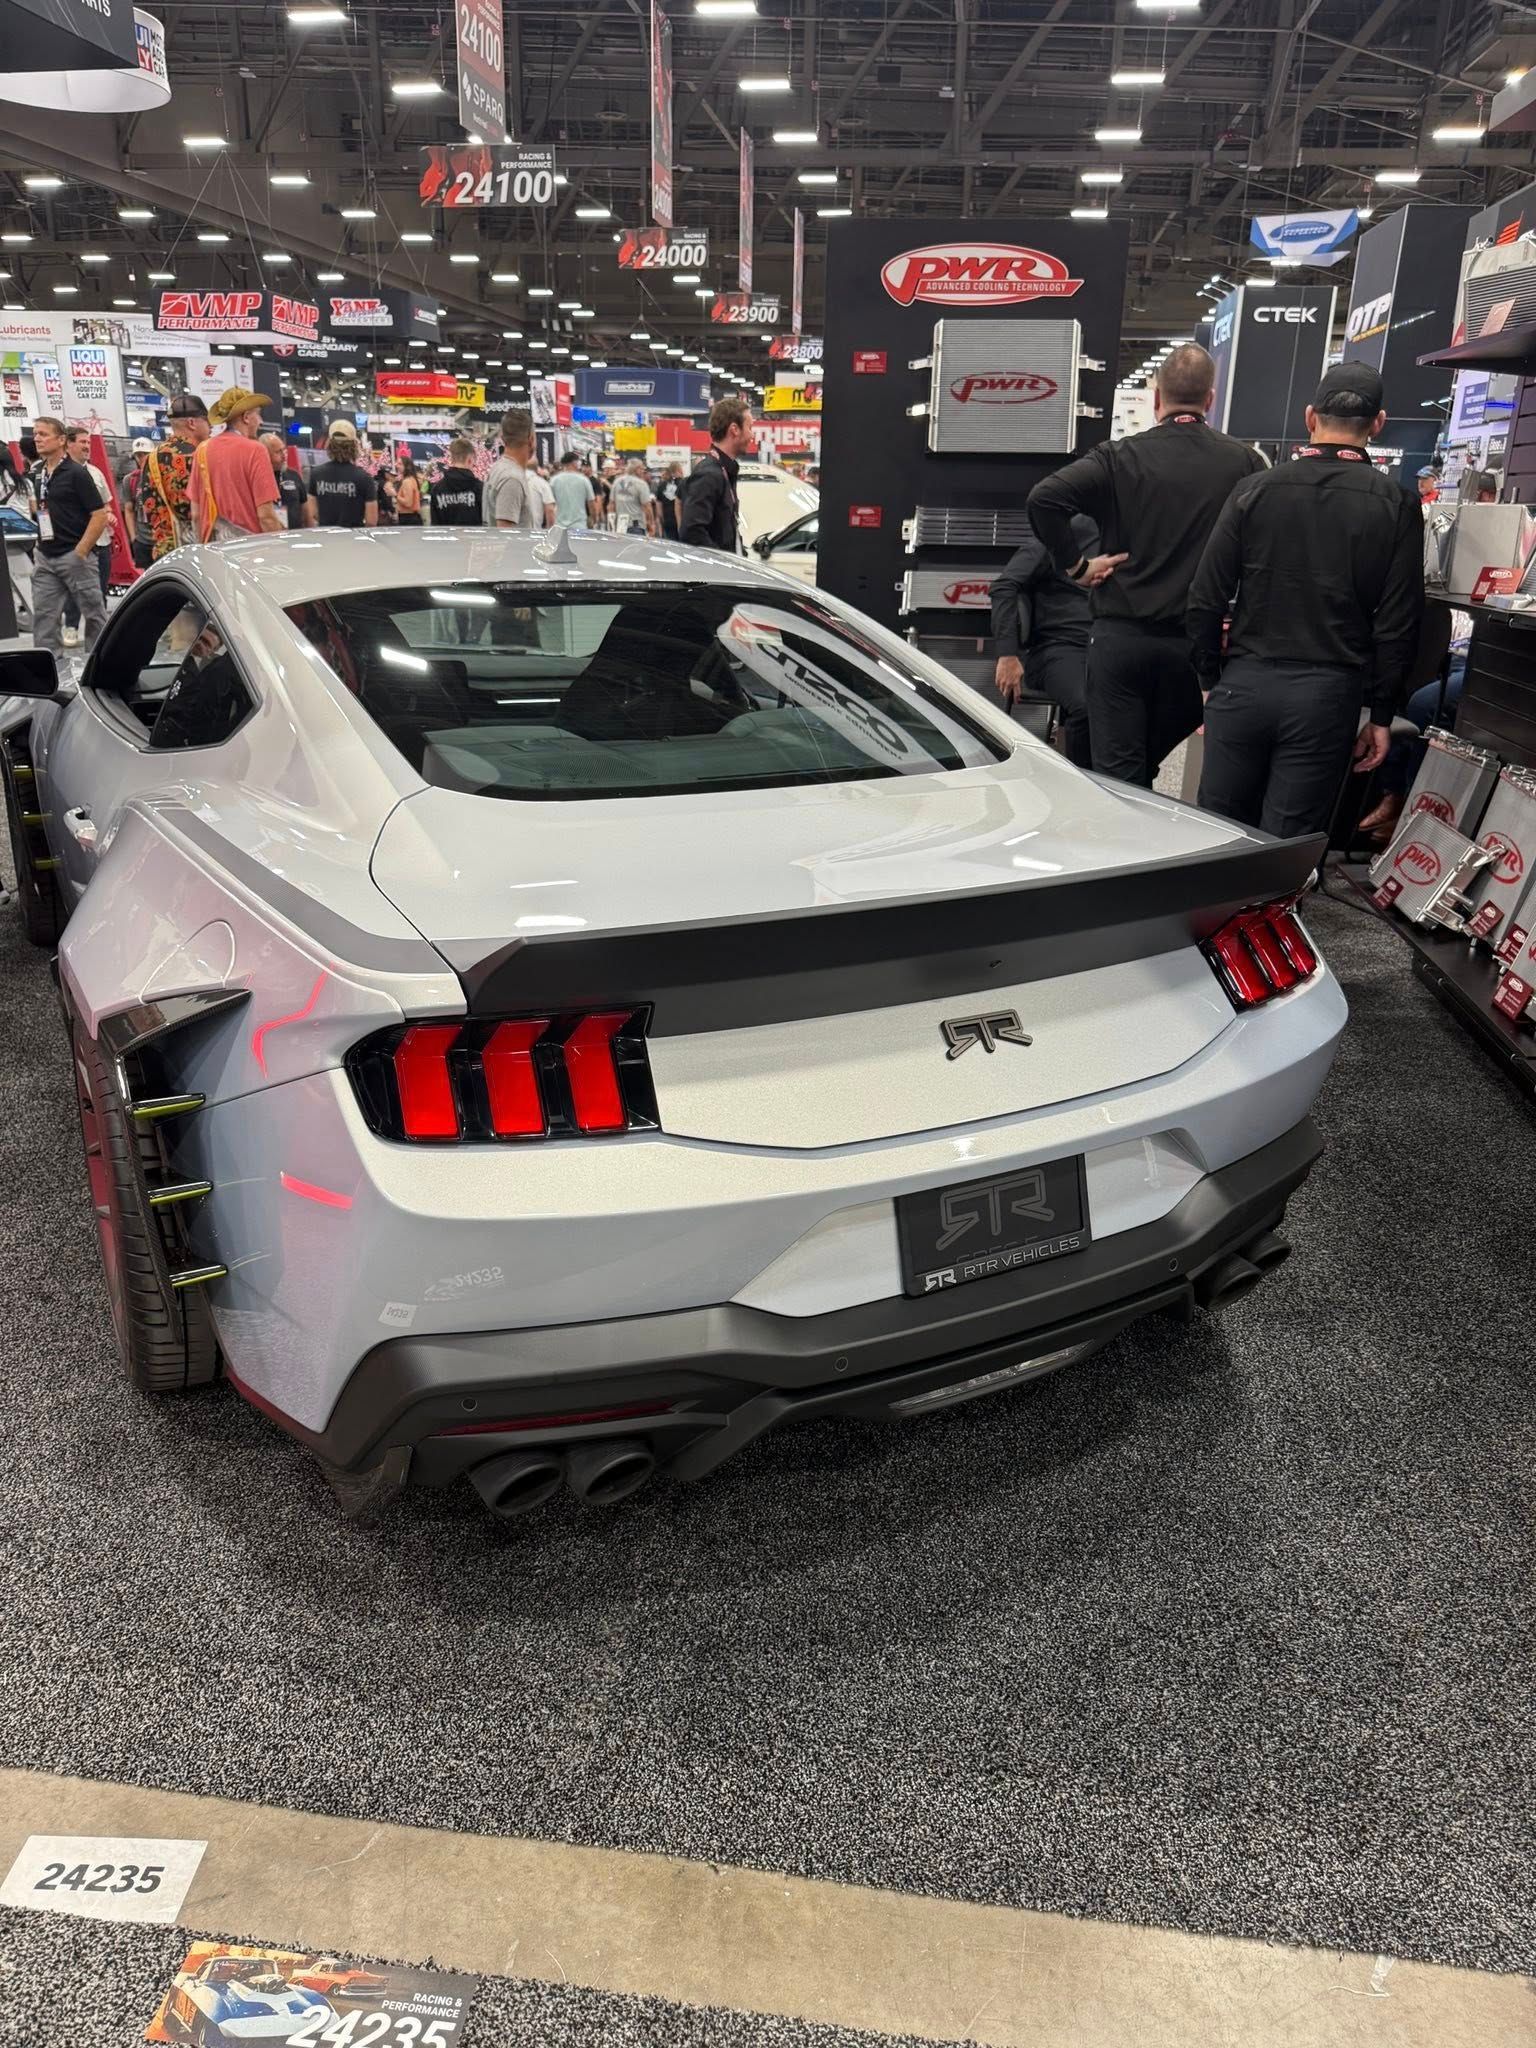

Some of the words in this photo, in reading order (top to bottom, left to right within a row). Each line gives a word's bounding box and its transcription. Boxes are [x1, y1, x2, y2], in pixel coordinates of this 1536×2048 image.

[461, 4, 501, 73] 24100
[473, 83, 504, 126] SPARQ
[501, 161, 552, 169] PERFORMANCE
[455, 171, 551, 204] 24100
[641, 245, 707, 266] 24000
[897, 256, 1044, 304] PWR
[926, 281, 971, 292] ADVANCED
[973, 282, 1009, 292] COOLING
[1012, 282, 1067, 292] TECHNOLOGY
[187, 292, 262, 317] VMP
[282, 299, 320, 328] VMP
[729, 306, 778, 323] 23900
[1253, 307, 1318, 323] CTEK
[0, 325, 51, 335] ubricants
[158, 317, 259, 330] PERFORMANCE
[71, 350, 104, 362] LIQUI
[297, 349, 329, 358] CARS
[783, 345, 823, 360] 23800
[72, 363, 107, 376] MOLY
[957, 378, 1041, 404] PWR
[1394, 843, 1437, 879] PWR
[940, 1008, 1034, 1061] RTR
[925, 1268, 957, 1292] RTR
[964, 1259, 998, 1278] RTR
[1000, 1236, 1080, 1267] VEHICLES
[33, 1862, 166, 1895] 24235
[381, 1999, 460, 2019] PERFORMANCE
[413, 1992, 453, 2007] RACING
[455, 1997, 463, 2007] &
[285, 2003, 457, 2048] 24235
